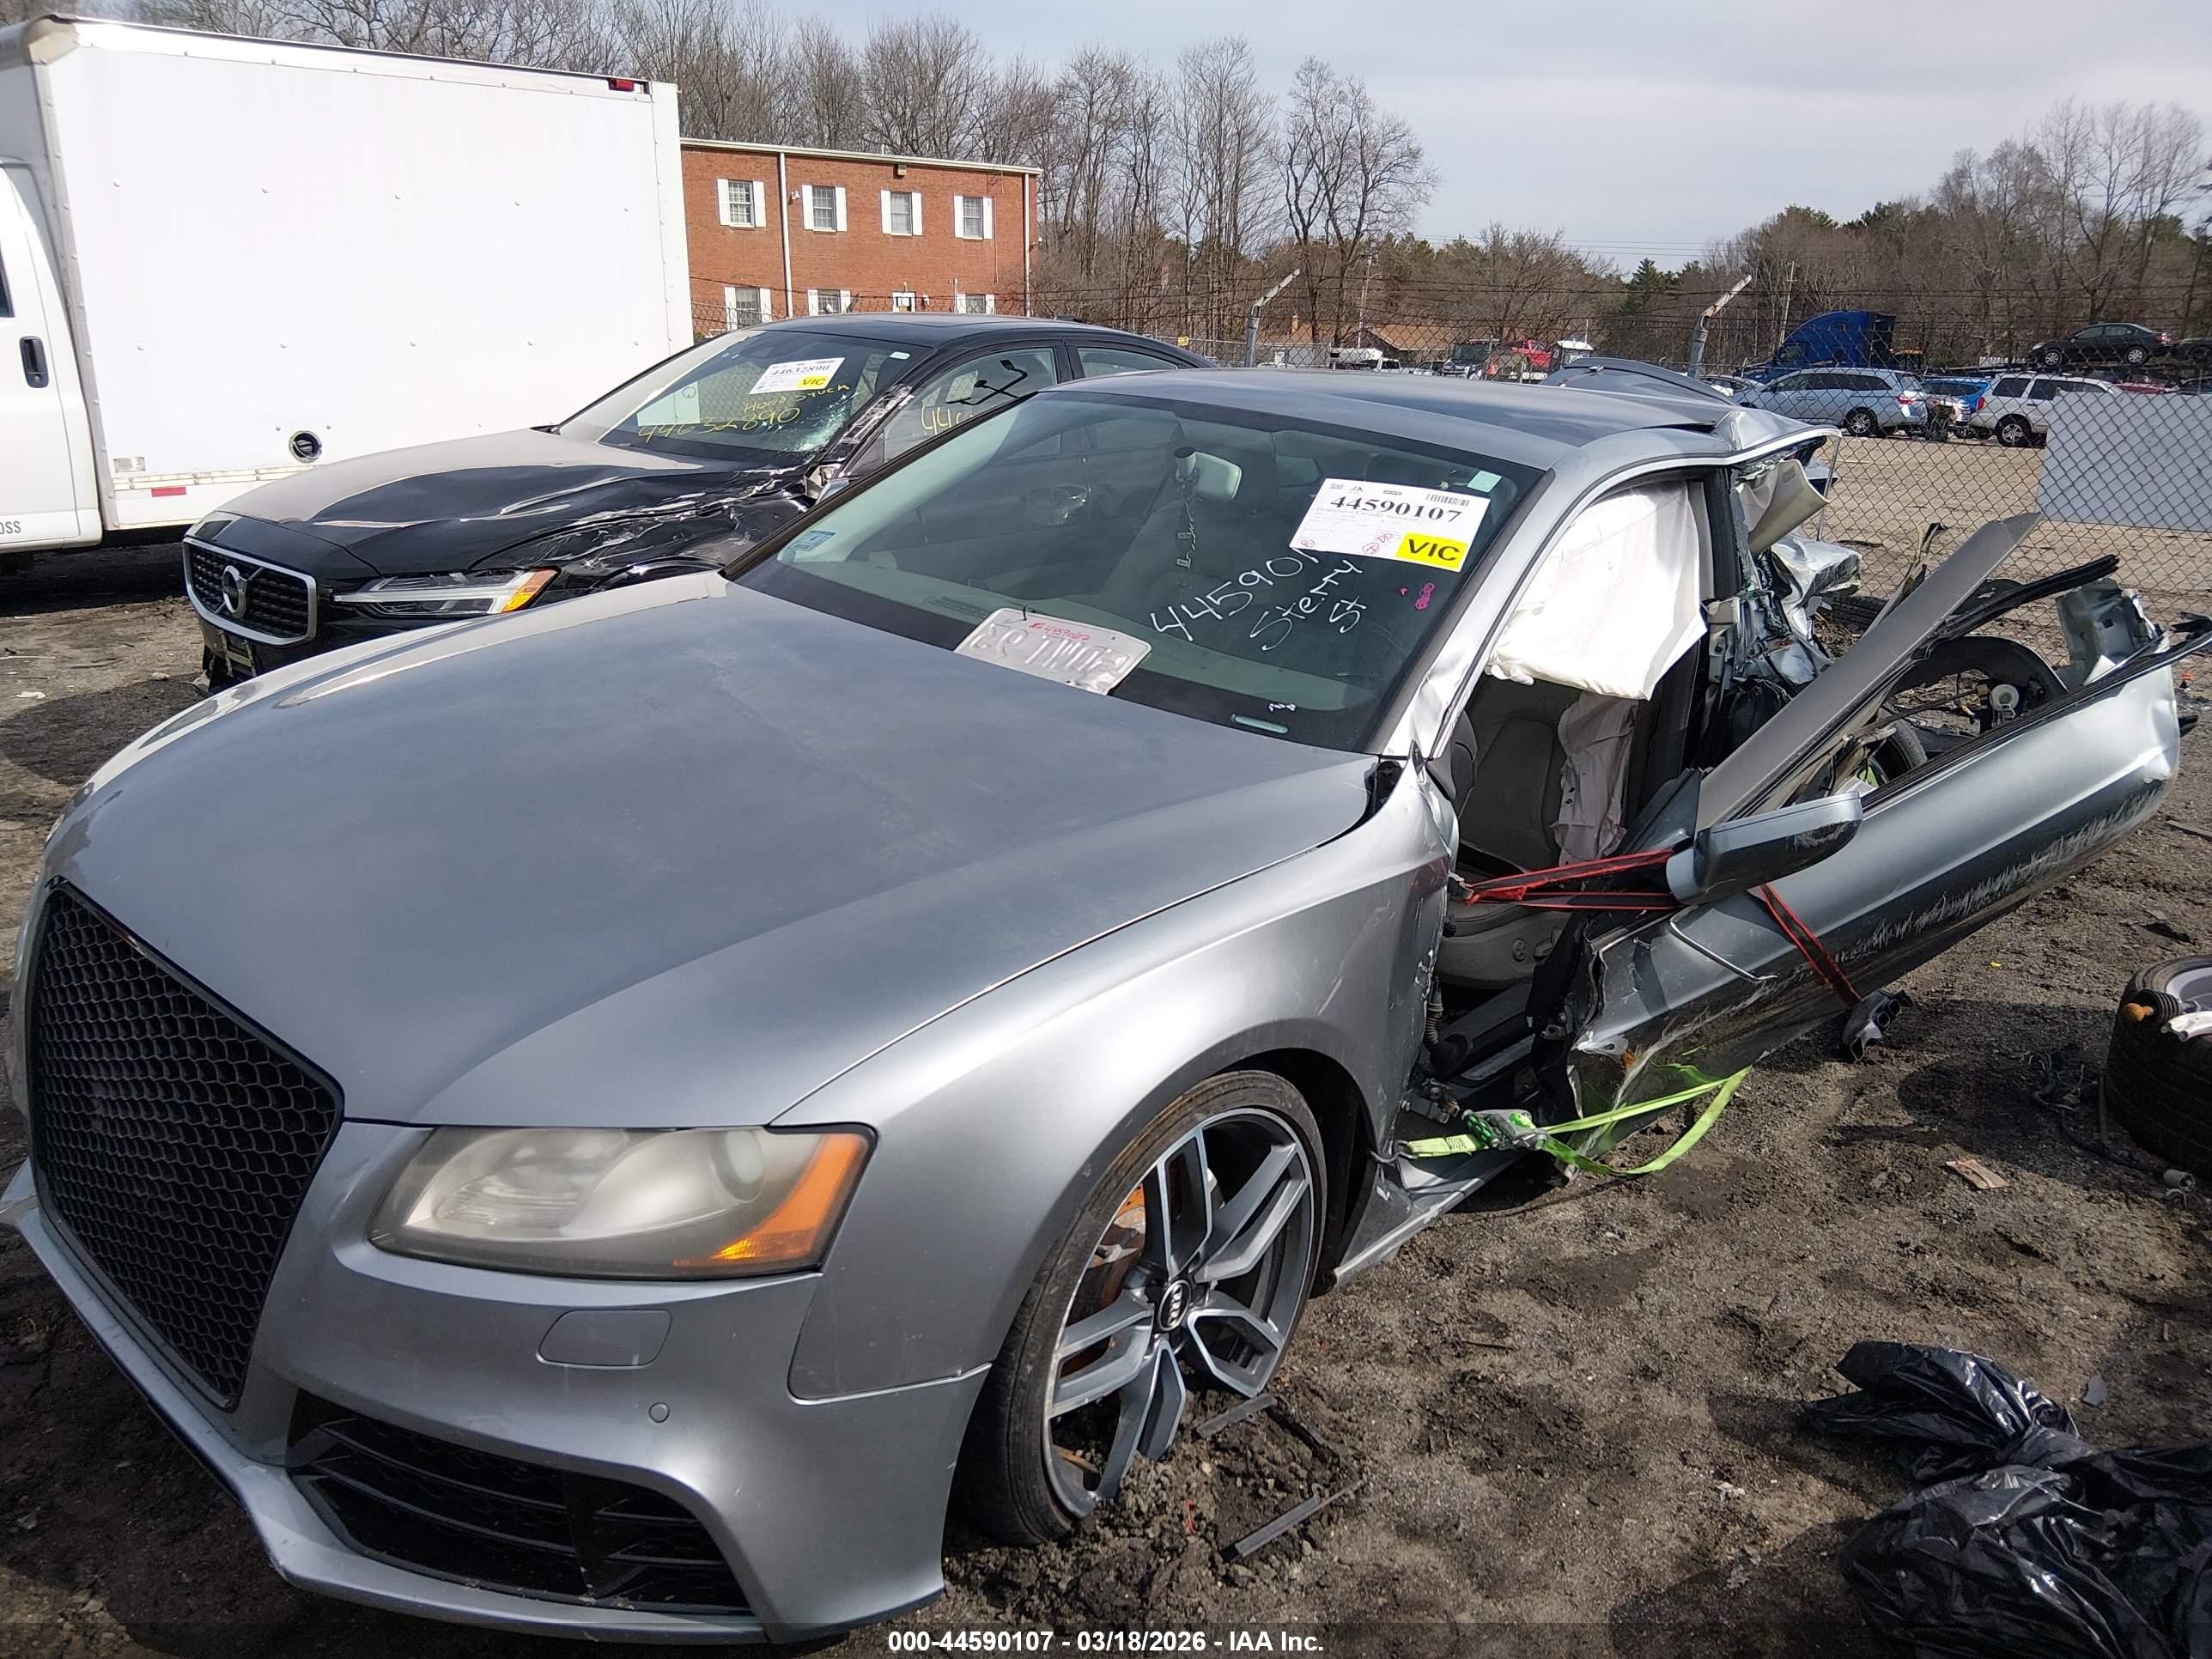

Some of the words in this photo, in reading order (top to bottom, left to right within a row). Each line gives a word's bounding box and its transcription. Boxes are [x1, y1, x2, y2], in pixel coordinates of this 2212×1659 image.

[1329, 495, 1463, 523] 44590107
[1408, 538, 1460, 561] VIC
[1329, 596, 1367, 634] St
